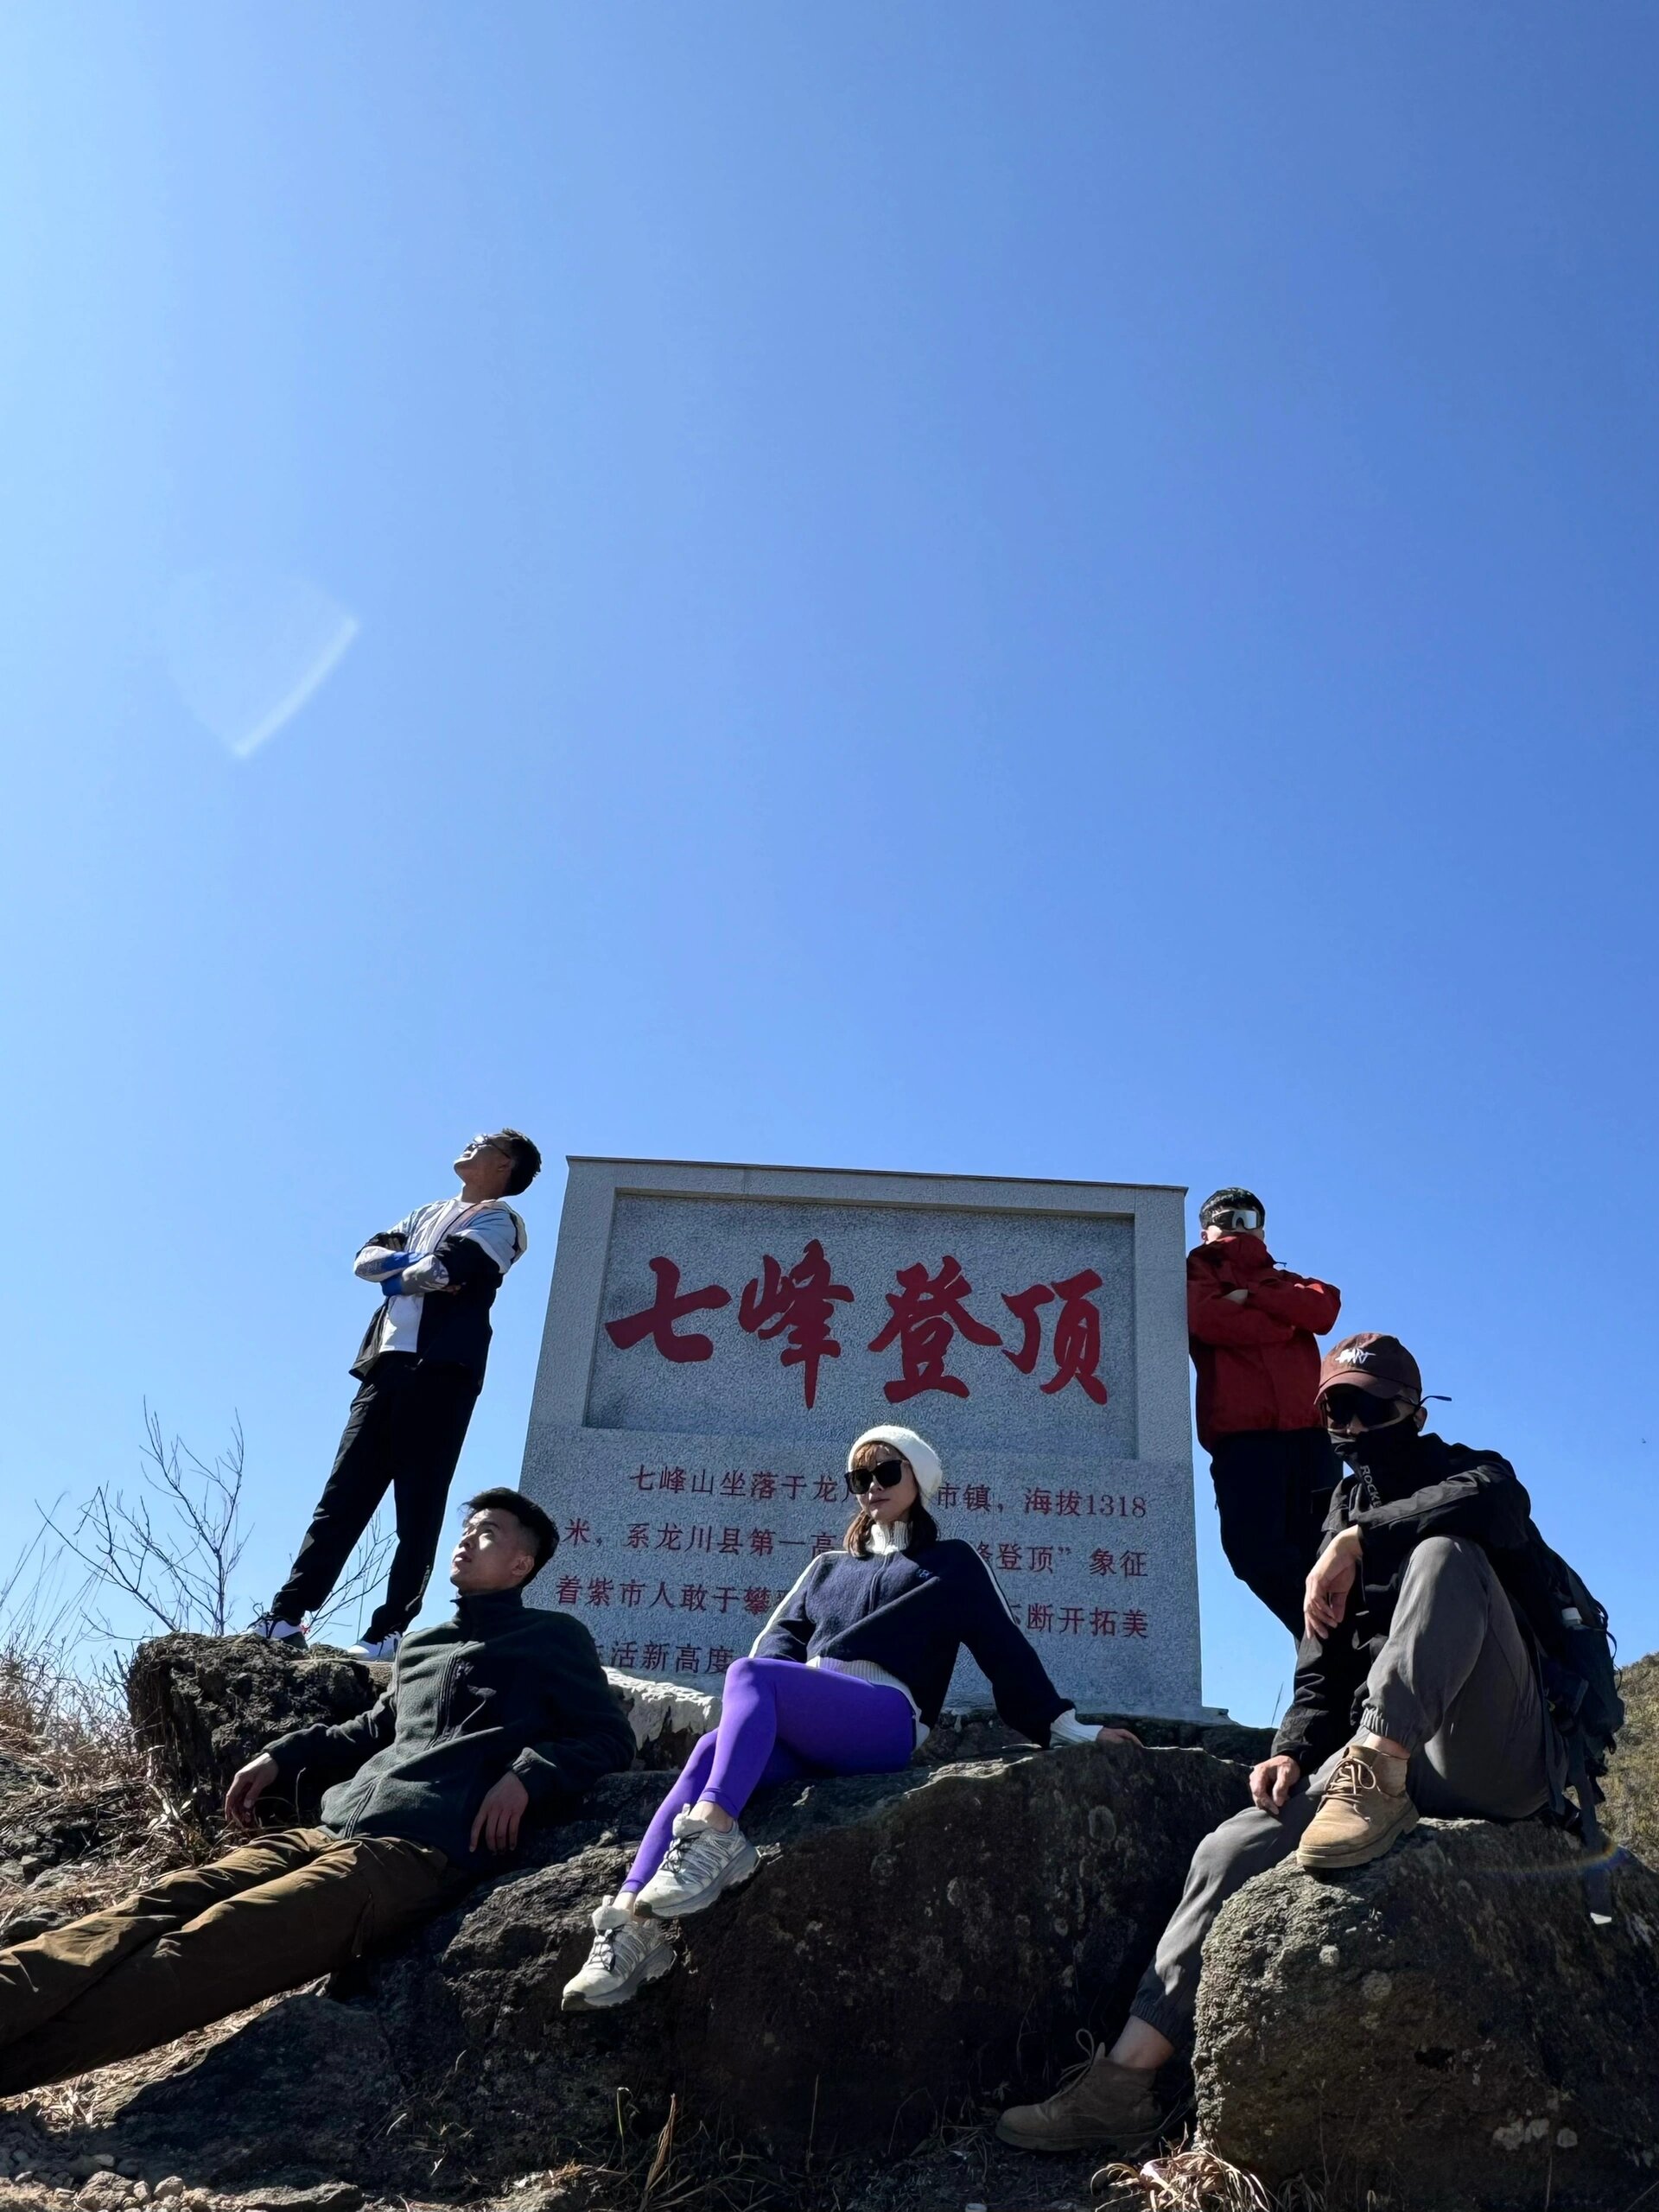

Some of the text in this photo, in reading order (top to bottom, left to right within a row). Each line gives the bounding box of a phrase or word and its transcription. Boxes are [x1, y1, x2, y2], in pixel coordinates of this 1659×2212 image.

[605, 1238, 1108, 1409] 七峰登顶
[629, 1464, 850, 1503] 七峰山坐落于龙
